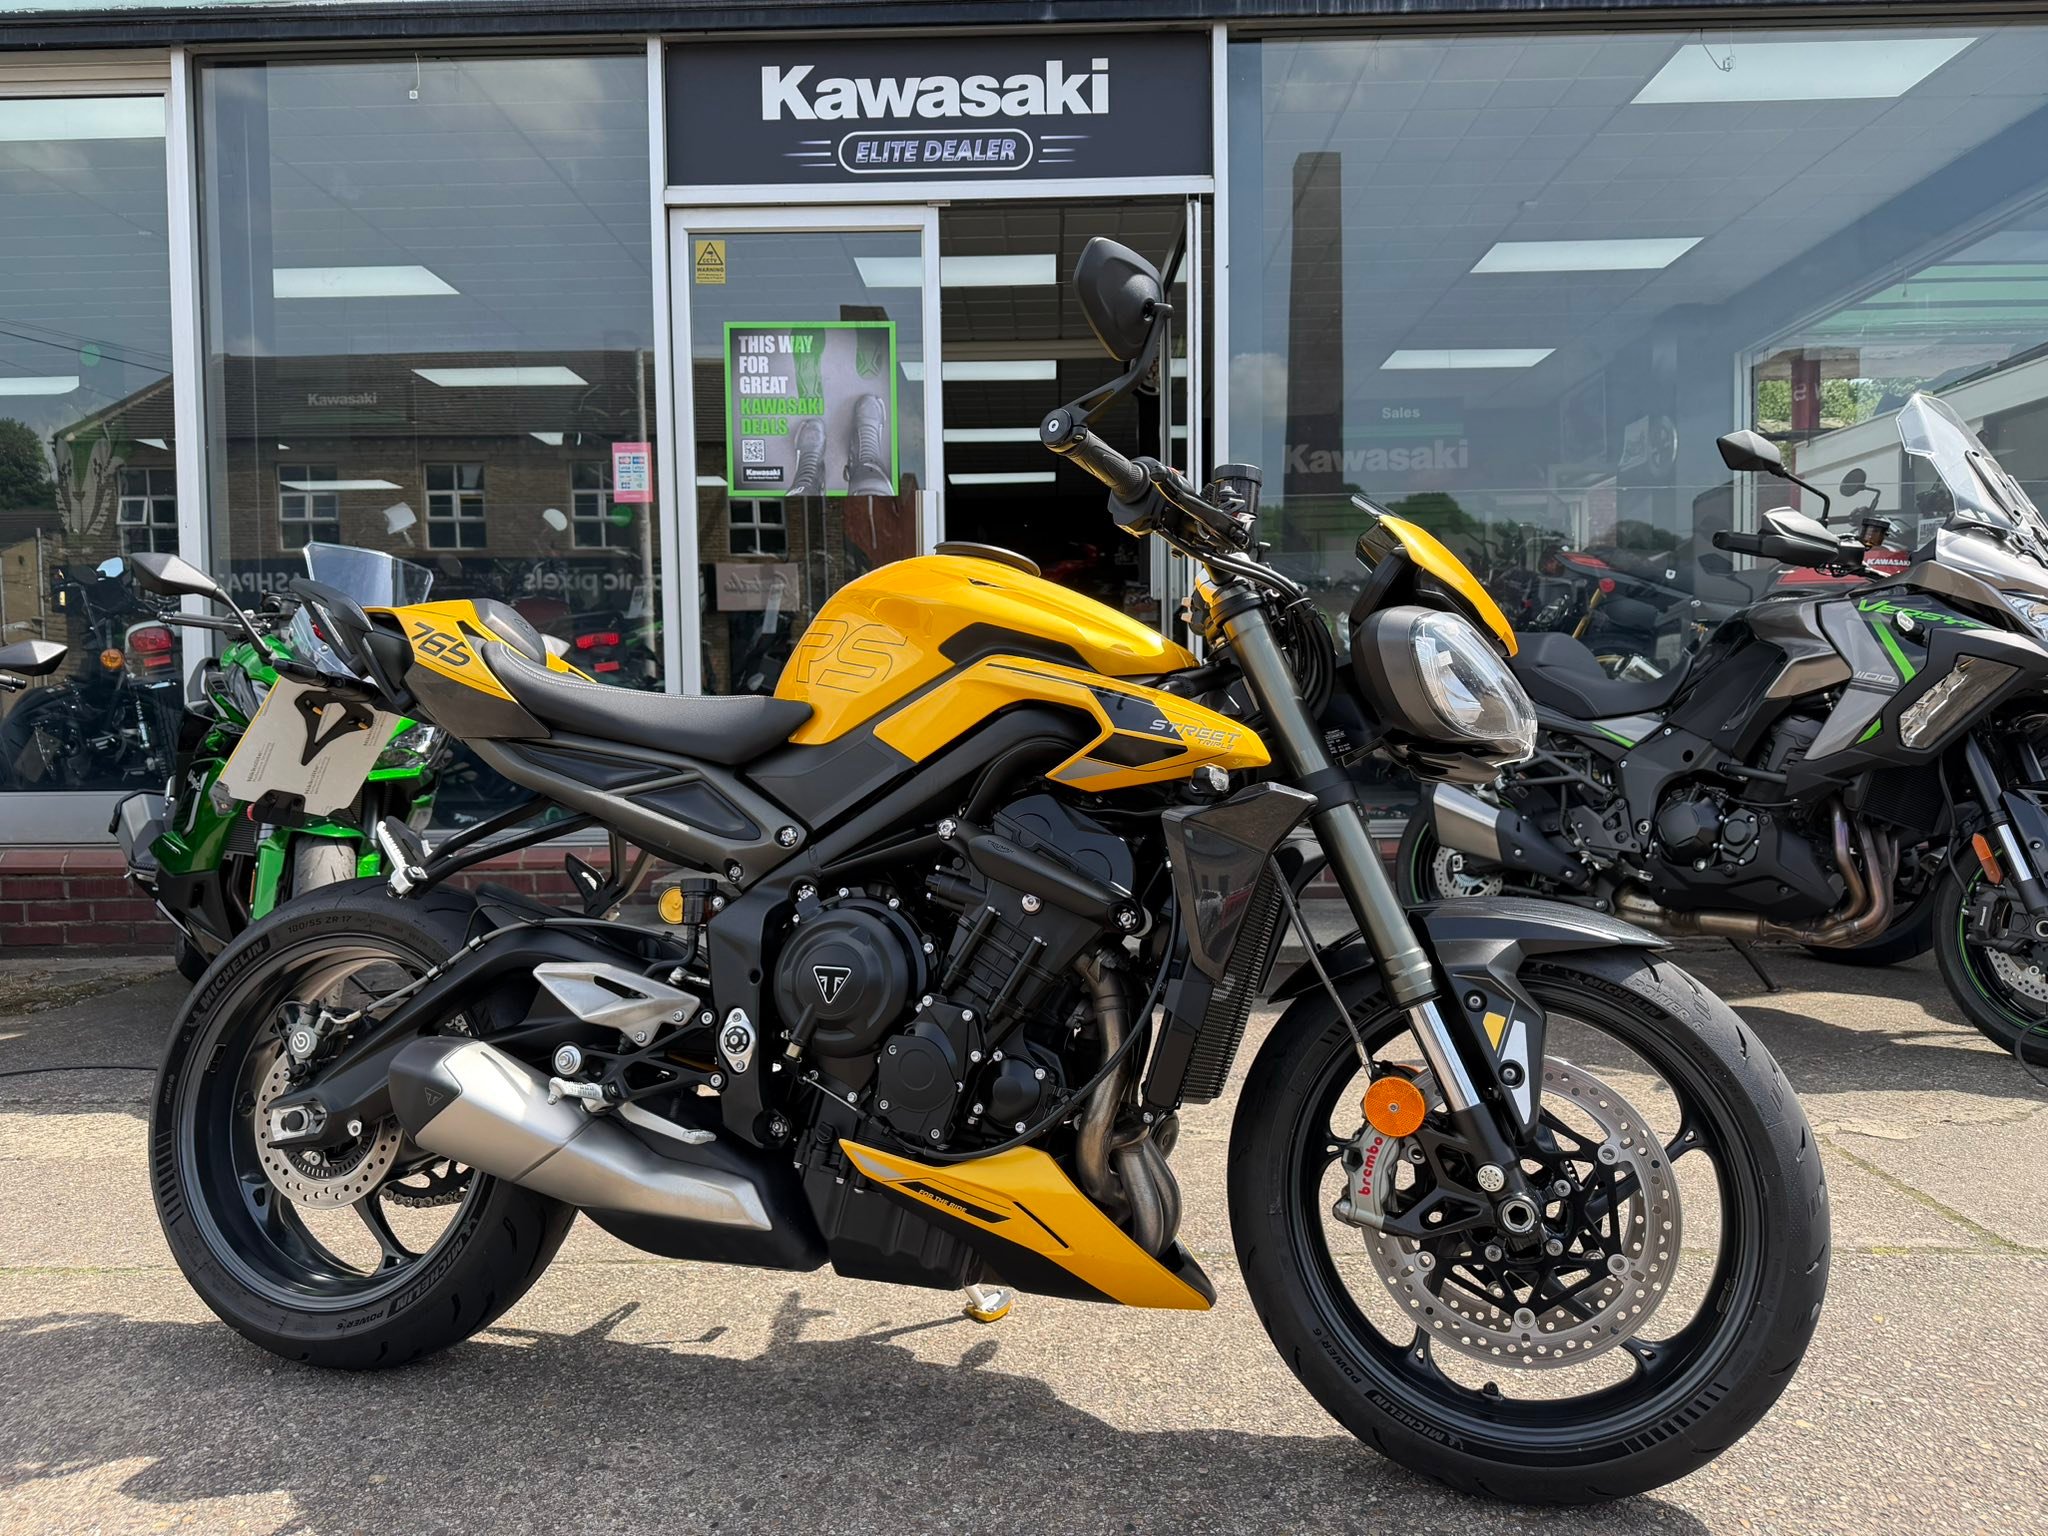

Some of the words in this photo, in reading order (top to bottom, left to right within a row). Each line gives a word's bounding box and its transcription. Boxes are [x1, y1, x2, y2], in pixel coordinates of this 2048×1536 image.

[761, 58, 1109, 121] Kawasaki
[856, 141, 918, 164] ELITE
[924, 138, 1017, 162] DEALER
[738, 335, 775, 353] THIS
[778, 335, 813, 353] WAY
[739, 356, 769, 374] FOR
[740, 377, 788, 394] GREAT
[307, 392, 377, 406] Kawasaki
[740, 398, 824, 416] KAWASAKI
[1382, 407, 1420, 419] Sales
[741, 418, 789, 435] DEALS
[1283, 439, 1469, 475] Kawasaki
[411, 621, 471, 667] 765
[796, 619, 908, 694] RS
[1856, 671, 1896, 682] 1100
[1149, 719, 1241, 743] STREET
[1198, 739, 1234, 750] TRIPLE
[325, 916, 340, 924] ZR
[199, 942, 265, 1012] MICHELIN
[1584, 975, 1661, 1019] MICHELIN
[1358, 1136, 1383, 1195] brembo
[919, 1189, 934, 1199] FOR
[934, 1195, 949, 1206] THE
[949, 1202, 968, 1213] RIDE
[395, 1238, 463, 1311] MICHELIN
[346, 1310, 383, 1330] POWER
[1312, 1327, 1322, 1337] 6
[1321, 1339, 1362, 1385] POWER
[1371, 1393, 1446, 1441] MICHELIN
